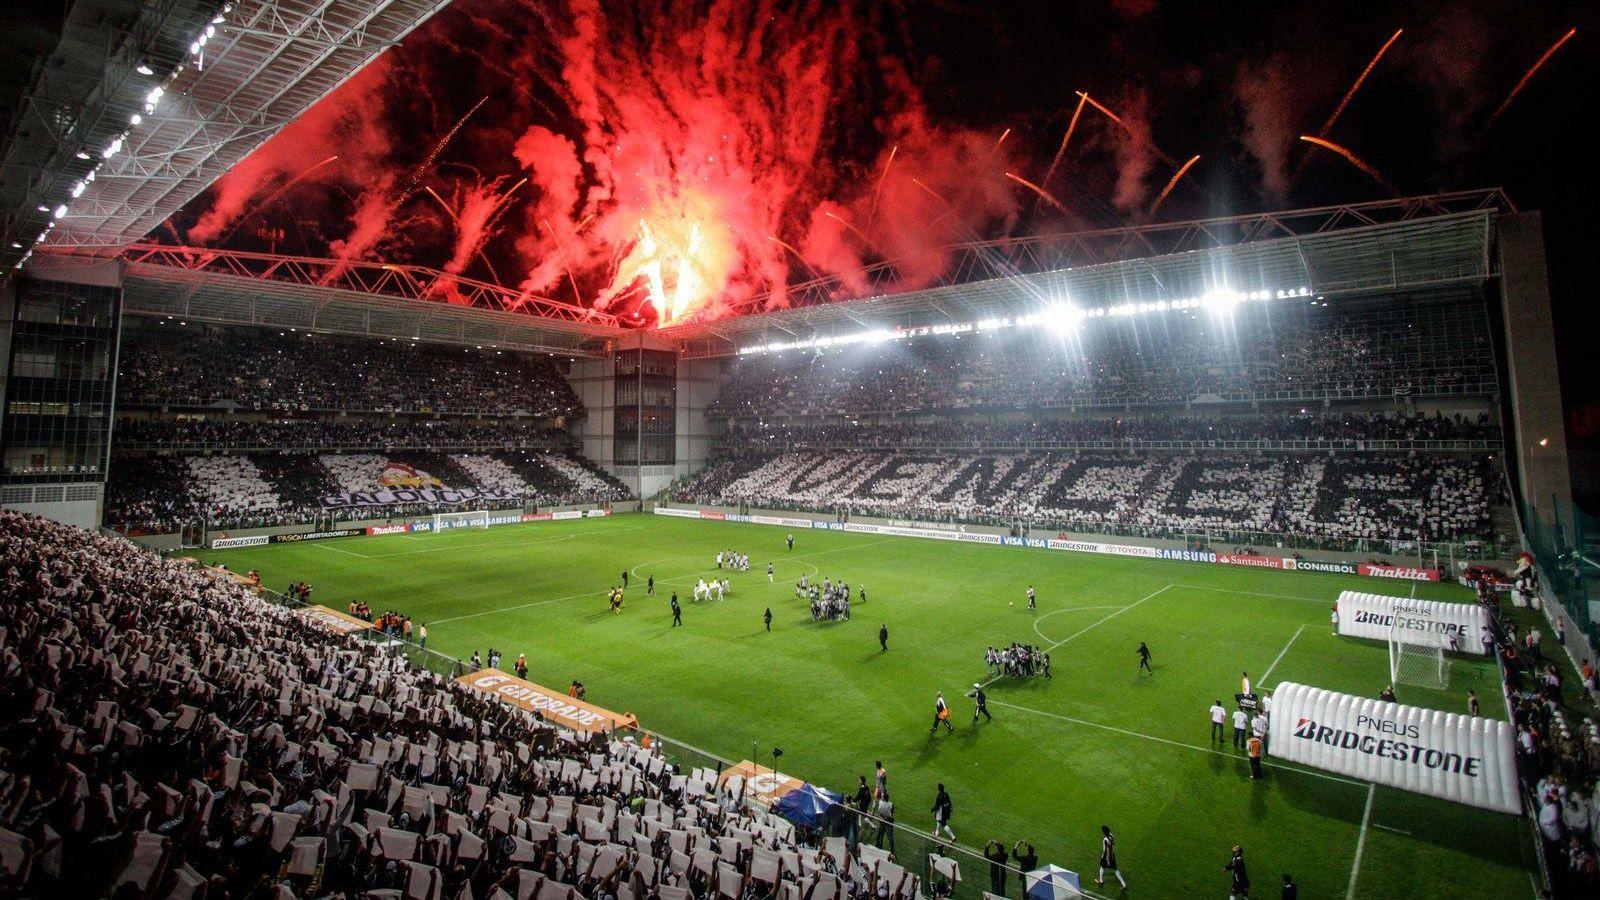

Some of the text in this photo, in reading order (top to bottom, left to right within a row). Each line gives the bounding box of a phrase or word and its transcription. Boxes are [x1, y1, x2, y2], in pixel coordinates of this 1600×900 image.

[413, 523, 430, 531] VISA
[433, 521, 449, 529] VSA
[214, 537, 268, 547] BRIDGESTONE
[958, 534, 998, 544] BRIDGESTONE
[1004, 536, 1022, 546] VISA
[1025, 538, 1045, 548] VISA
[1050, 541, 1098, 551] BRIDGESTONE
[1117, 546, 1147, 555] TOYOTA
[1155, 550, 1217, 562] SAMSUNG
[1230, 556, 1280, 568] Santander
[1298, 562, 1355, 574] CONMEBOL
[1392, 605, 1432, 617] PNEUS
[1354, 610, 1469, 637] BRIDGESTONE
[498, 685, 606, 725] GATORADE
[1356, 714, 1420, 739] PNEUS
[1294, 718, 1481, 778] BRIDGESTONE
